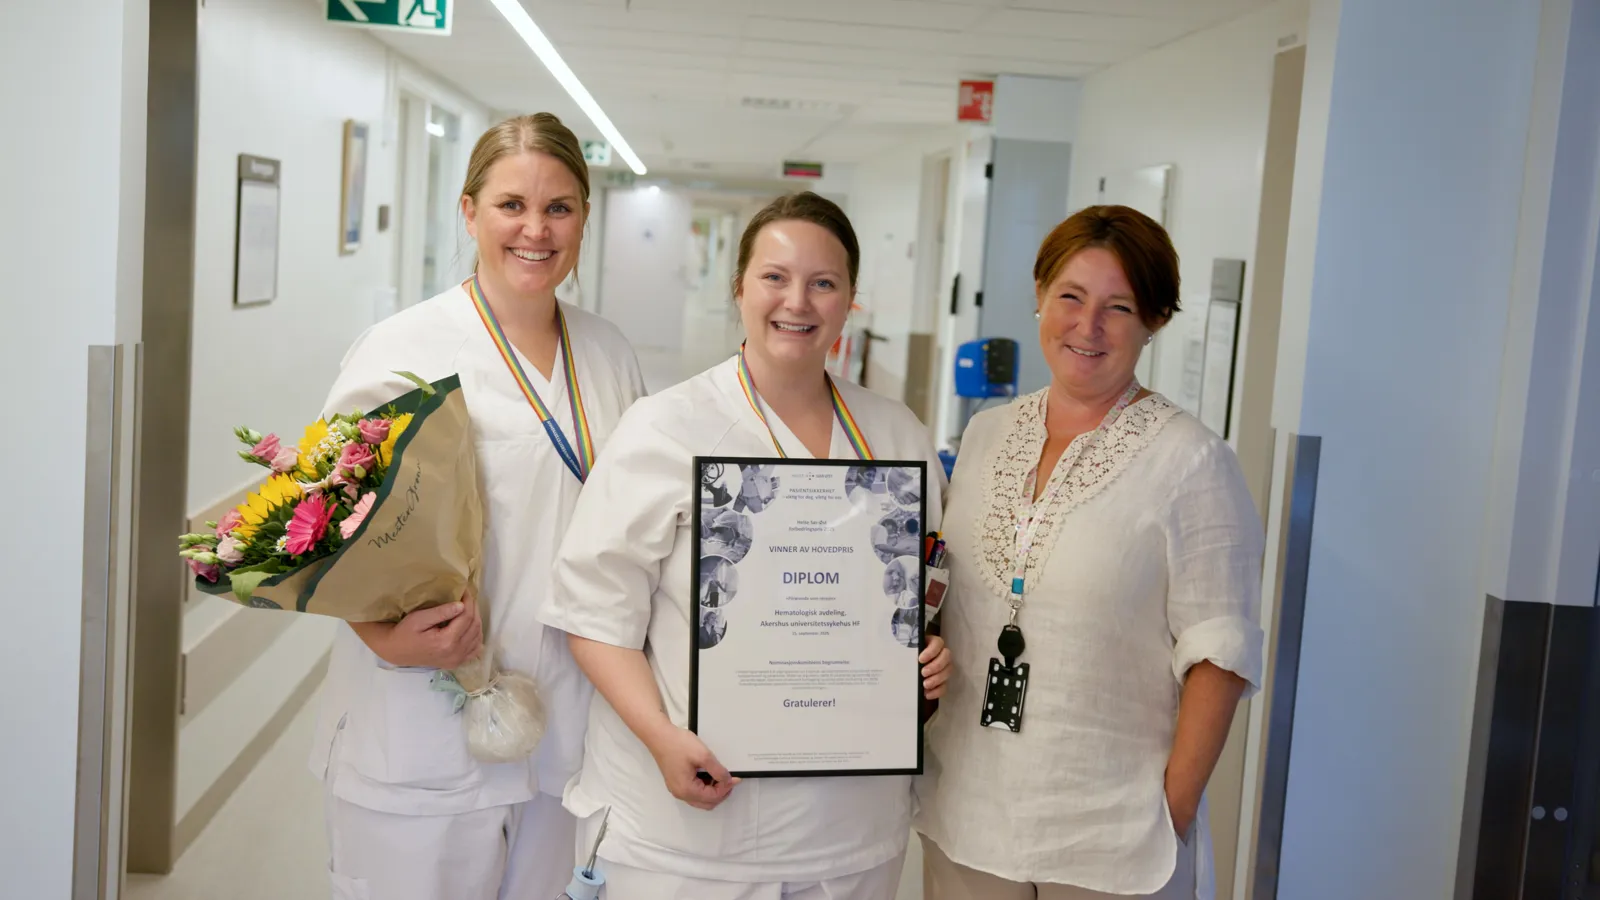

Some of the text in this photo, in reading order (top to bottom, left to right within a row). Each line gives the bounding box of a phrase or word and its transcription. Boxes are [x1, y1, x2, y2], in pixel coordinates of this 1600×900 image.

[783, 571, 840, 584] DIPLOM
[774, 609, 847, 617] Hematologisk avdeling,
[790, 620, 851, 628] universitetssykehus
[783, 698, 836, 708] Gratulerer!
